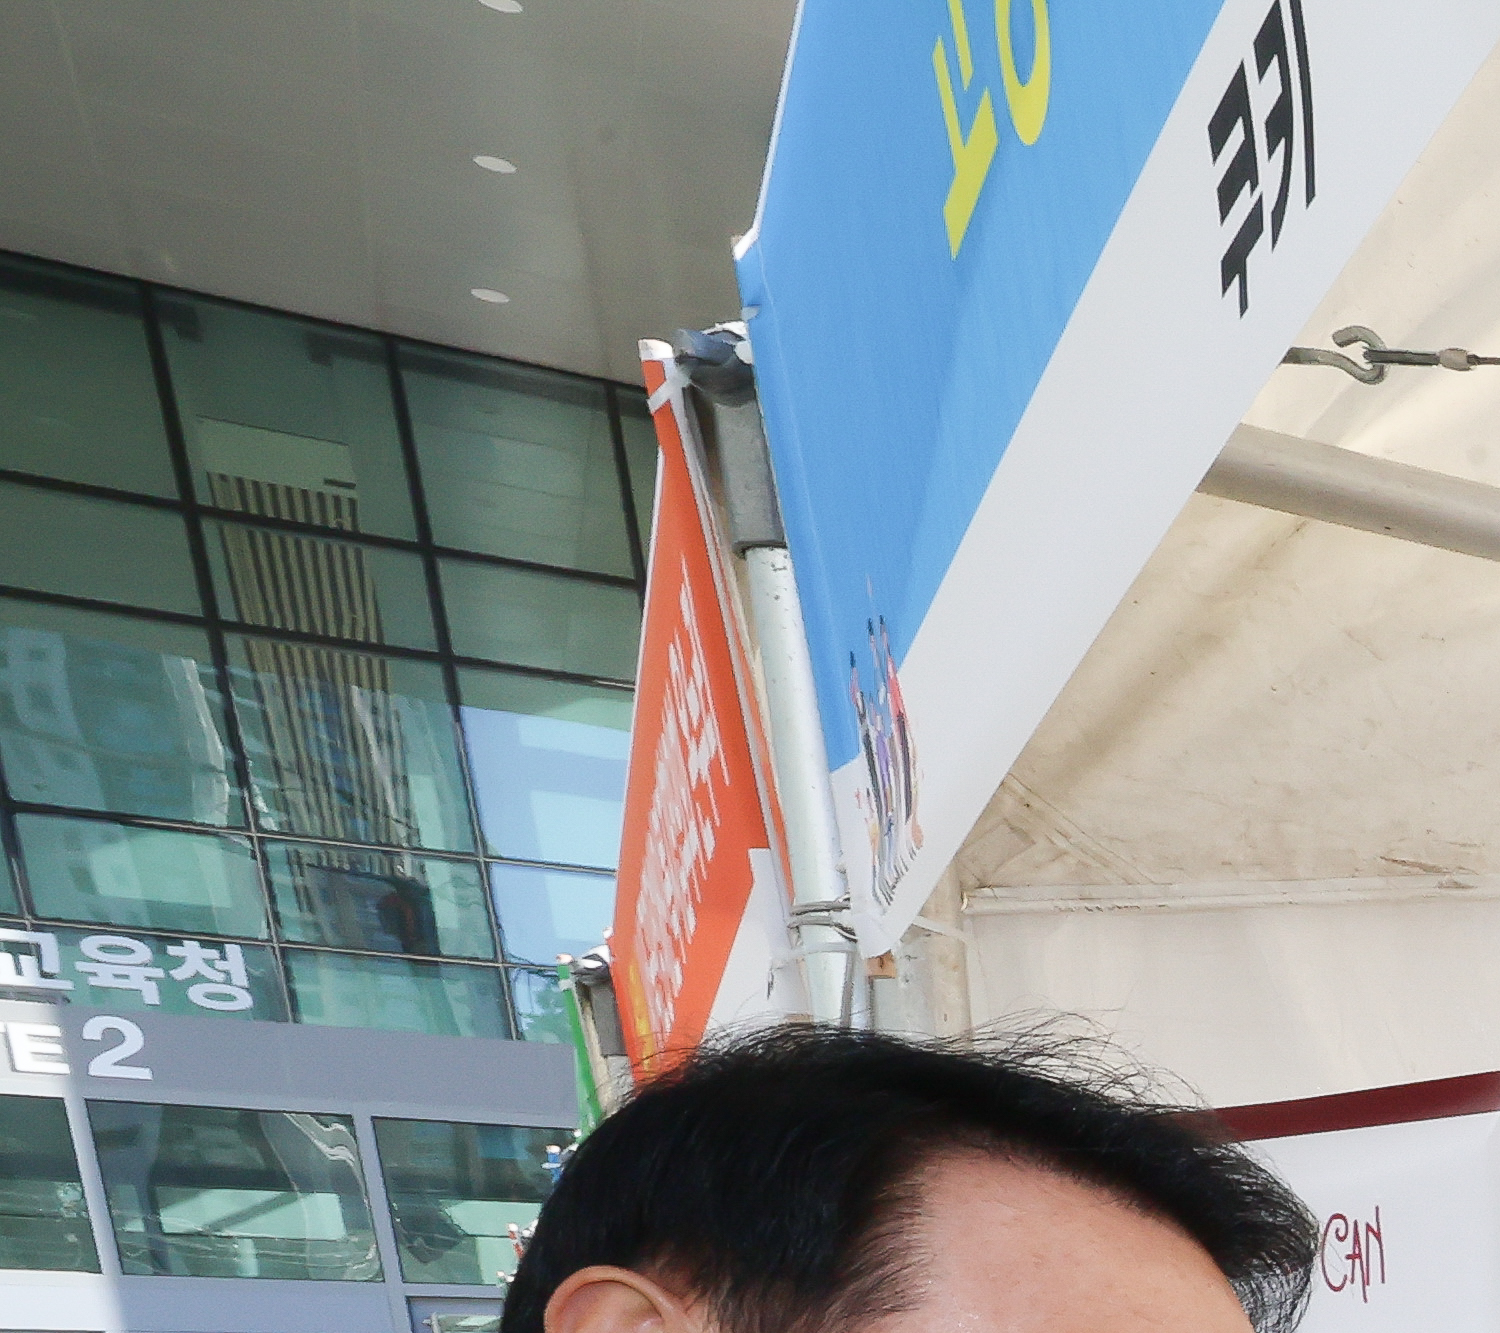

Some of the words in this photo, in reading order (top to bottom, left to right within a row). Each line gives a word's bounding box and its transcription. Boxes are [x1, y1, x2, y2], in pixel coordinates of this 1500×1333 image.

[0, 927, 254, 1011] 교육청
[0, 1021, 71, 1074] E
[82, 1015, 153, 1080] 2
